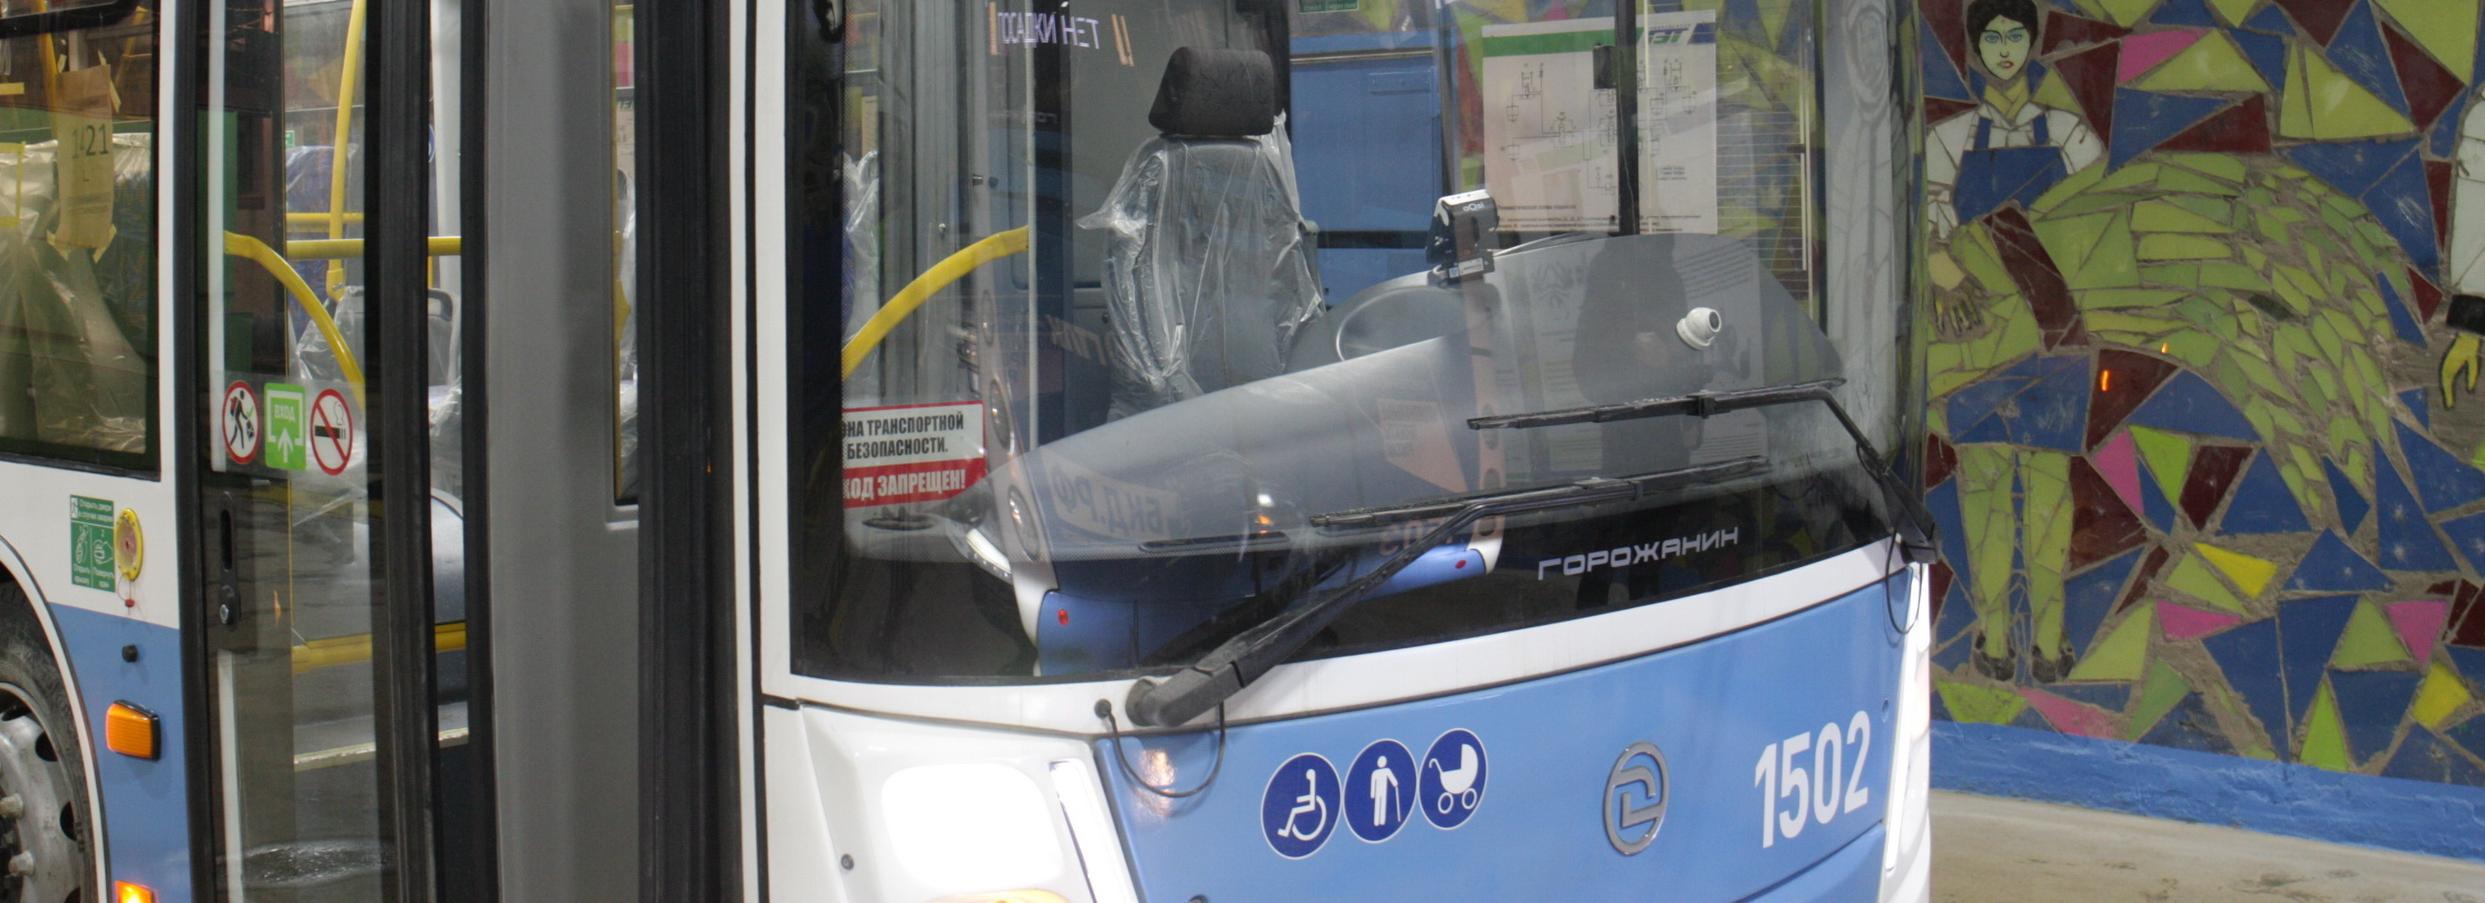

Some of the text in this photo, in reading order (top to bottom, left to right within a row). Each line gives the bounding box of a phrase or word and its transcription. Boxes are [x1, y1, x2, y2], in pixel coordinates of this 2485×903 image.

[1061, 14, 1100, 49] НЕТ
[866, 411, 965, 436] ТРАНСПОРТНОЙ
[846, 437, 949, 460] БЕЗОПАСНОСТИ.
[877, 468, 967, 497] ЗАПРЕЩЕН!
[1537, 526, 1739, 581] ГОРОЖАНИН
[1754, 710, 1871, 848] 1502
